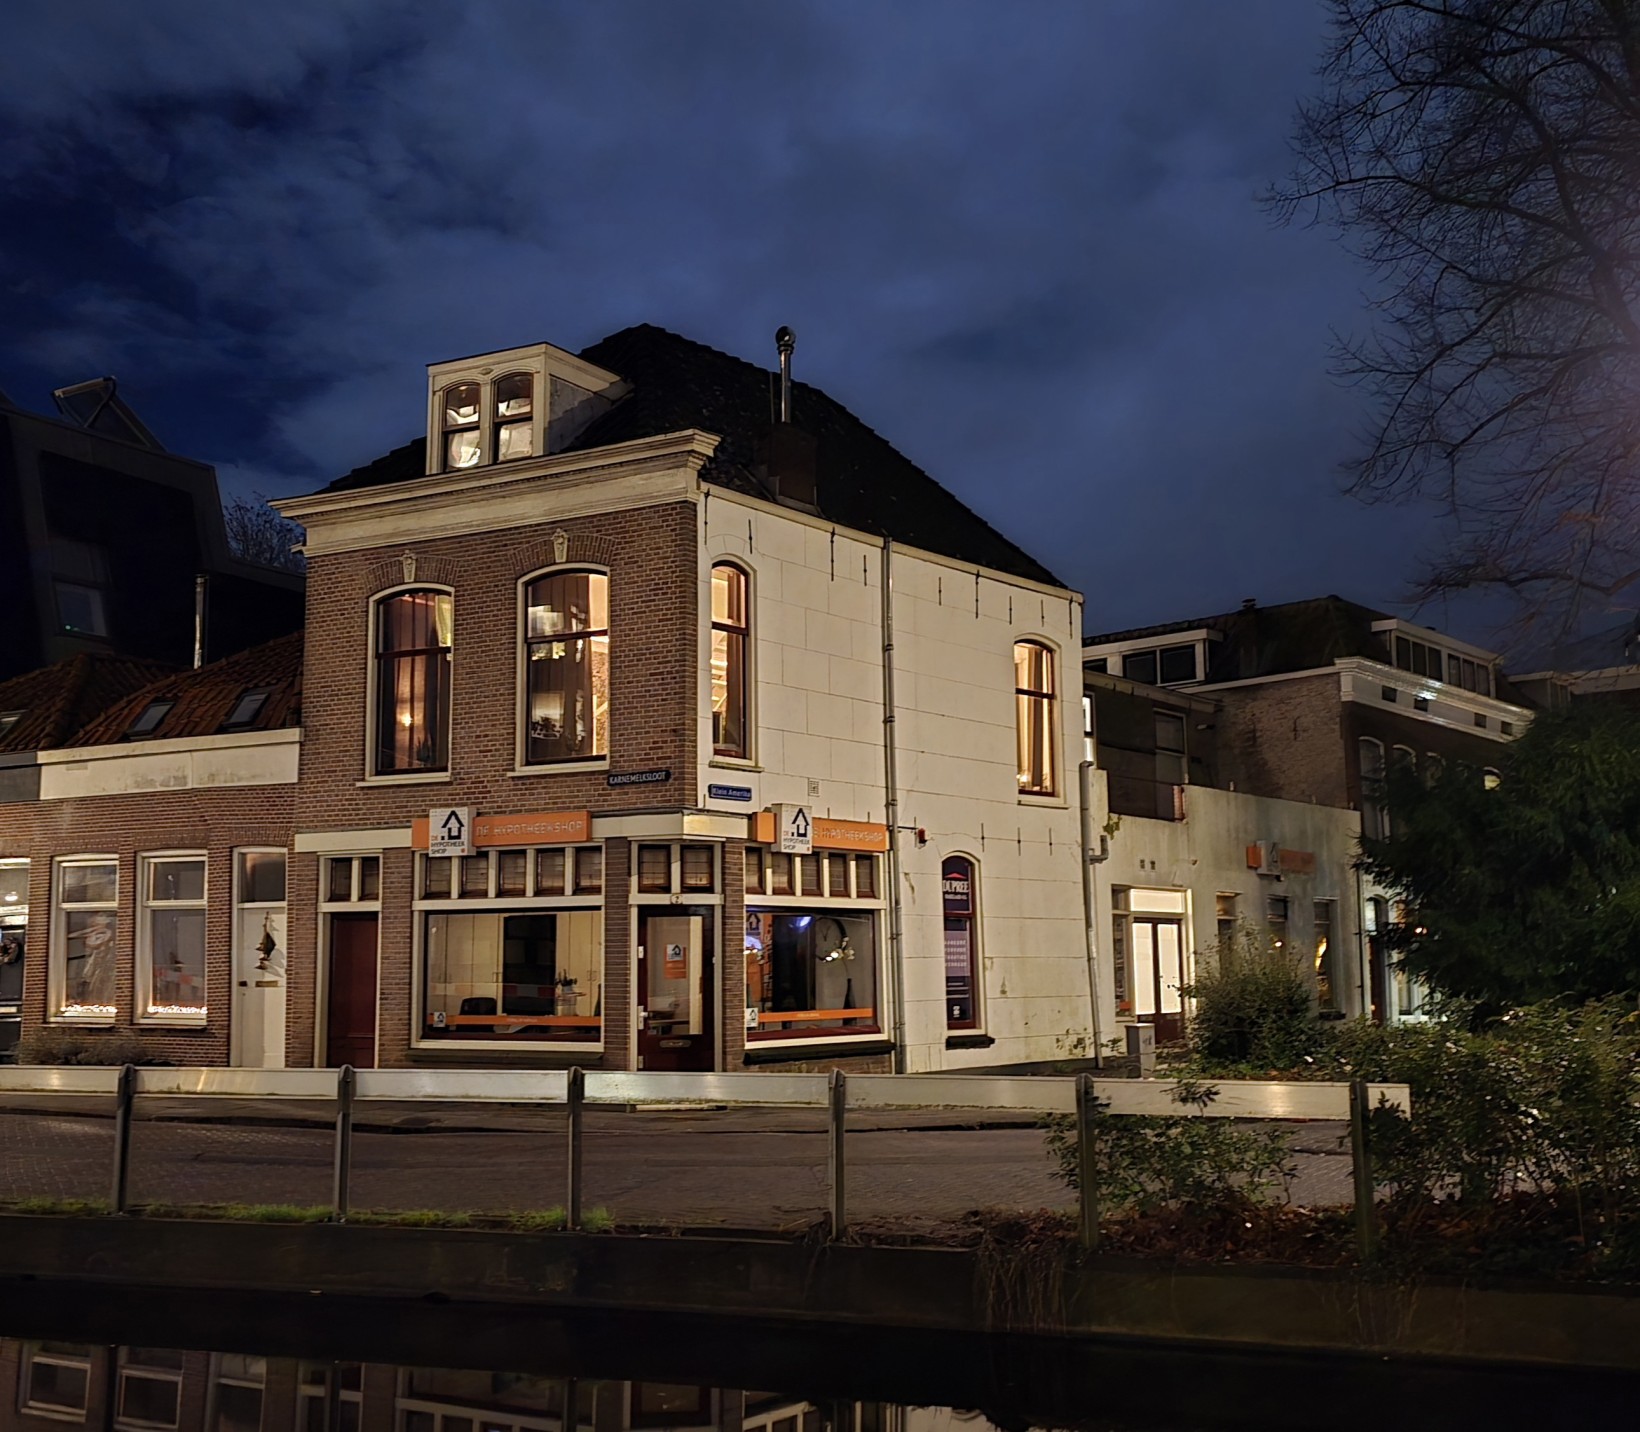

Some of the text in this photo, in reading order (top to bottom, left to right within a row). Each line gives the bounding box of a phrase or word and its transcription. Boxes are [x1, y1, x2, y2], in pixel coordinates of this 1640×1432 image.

[609, 771, 666, 784] KARNEMELKSLOOT
[476, 820, 583, 836] DE HYPOTHEEKSHOP
[822, 828, 884, 842] HYPOTHEEKSHOP
